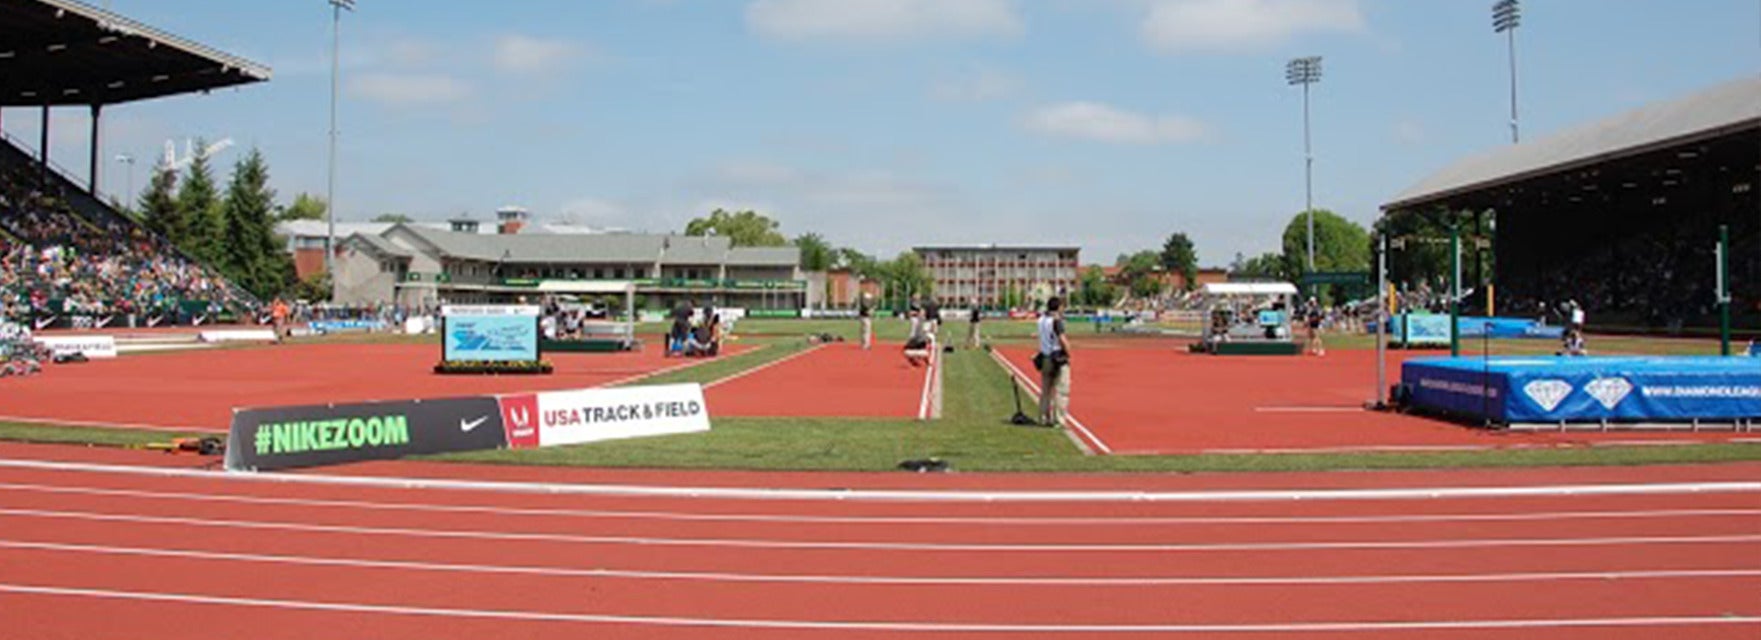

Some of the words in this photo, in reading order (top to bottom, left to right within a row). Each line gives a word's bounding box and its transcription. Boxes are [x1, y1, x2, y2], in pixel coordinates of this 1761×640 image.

[544, 410, 581, 427] USA
[583, 404, 640, 423] TRACK
[655, 401, 700, 418] FIELD
[255, 415, 409, 455] #NIKEZOOM
